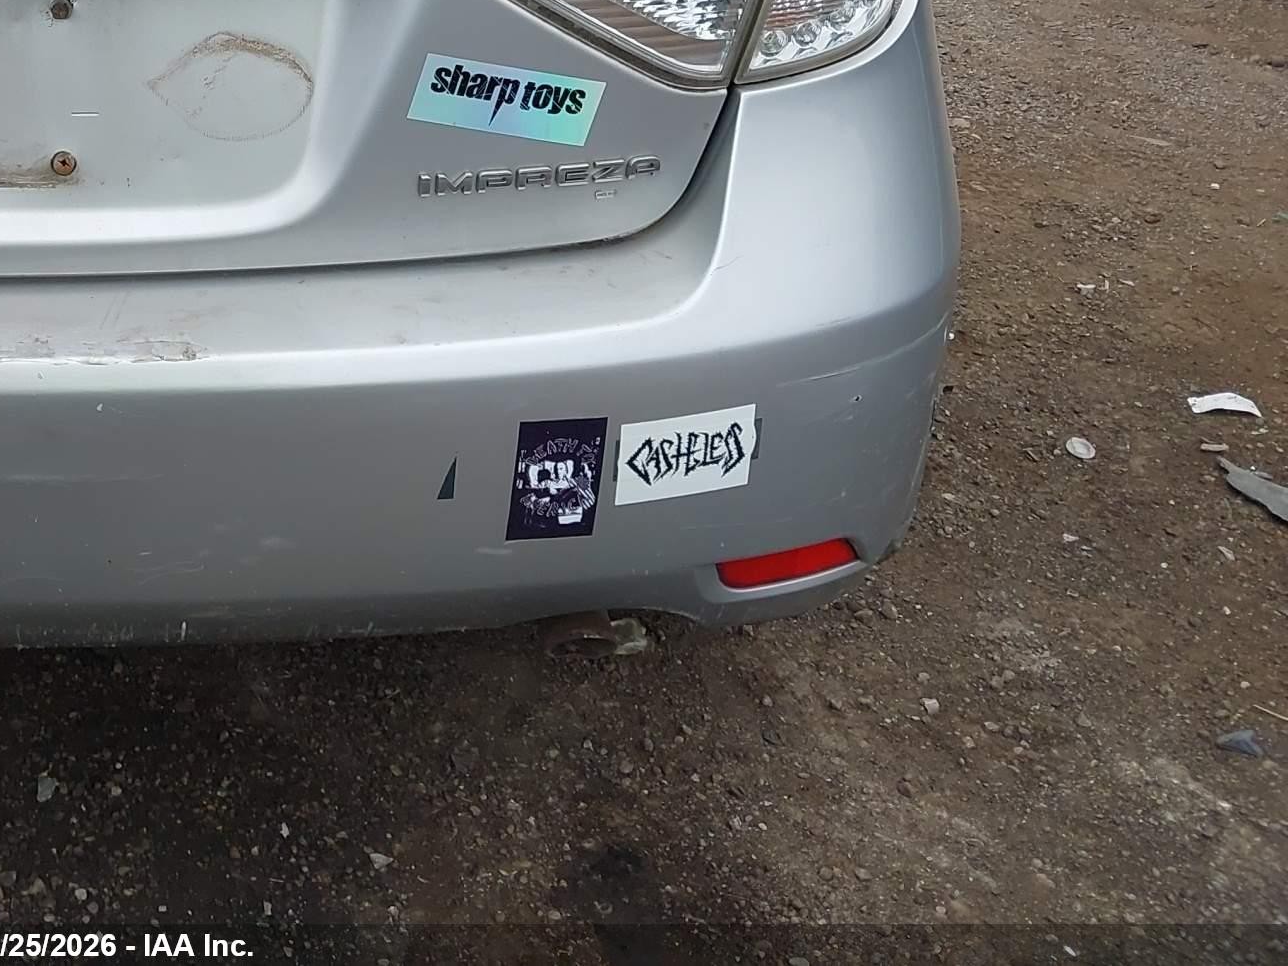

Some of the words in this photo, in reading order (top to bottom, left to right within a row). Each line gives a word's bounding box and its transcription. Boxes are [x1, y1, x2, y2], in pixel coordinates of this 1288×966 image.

[430, 64, 521, 127] sharp
[519, 81, 586, 115] toys
[417, 154, 661, 198] IMPREZA
